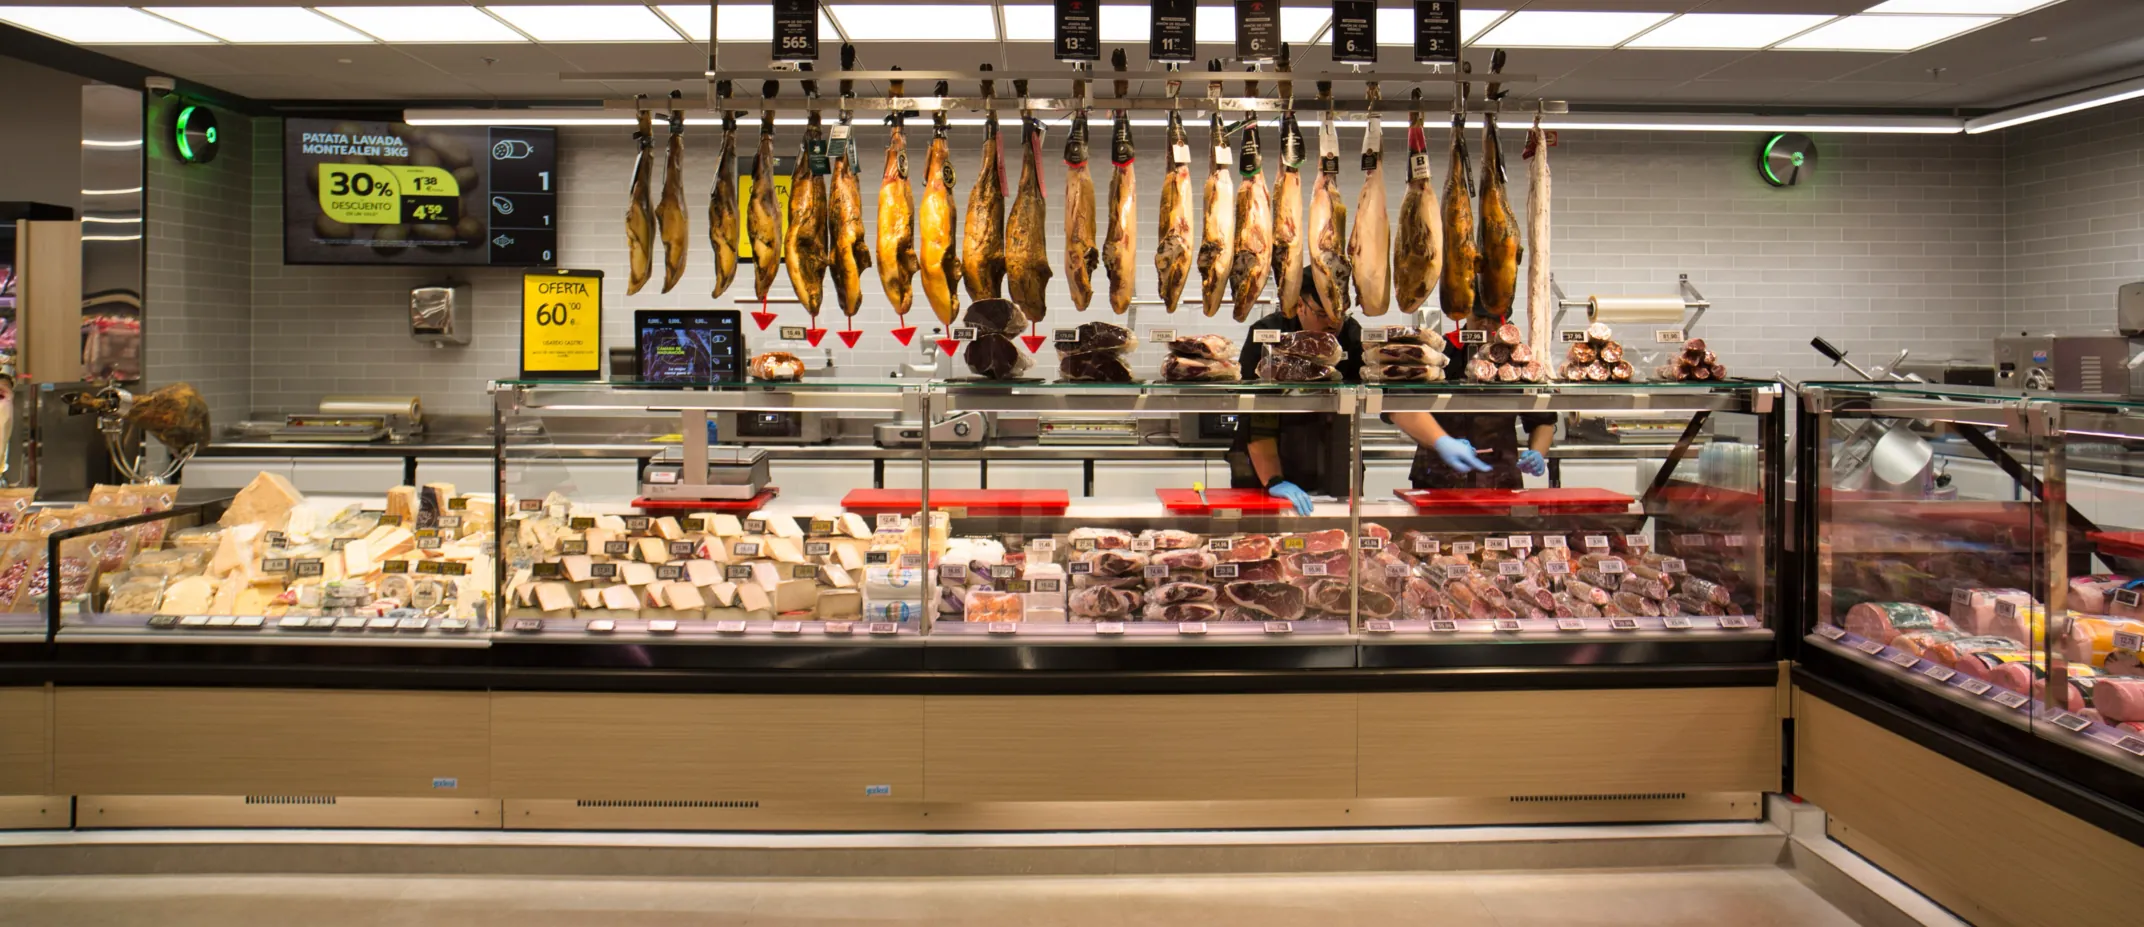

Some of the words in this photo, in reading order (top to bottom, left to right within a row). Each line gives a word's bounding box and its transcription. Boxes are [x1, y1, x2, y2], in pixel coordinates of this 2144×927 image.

[782, 36, 807, 49] 565
[302, 132, 349, 145] PATATA
[352, 135, 403, 146] LAVADA
[302, 144, 381, 156] MONTEALEN
[383, 147, 409, 157] 3KG
[329, 171, 394, 197] 30%
[538, 171, 550, 191] 1
[331, 201, 392, 211] DESCUENTO
[542, 215, 550, 226] 1
[542, 249, 551, 261] 0
[538, 282, 590, 298] OFERTA
[726, 346, 733, 355] 1
